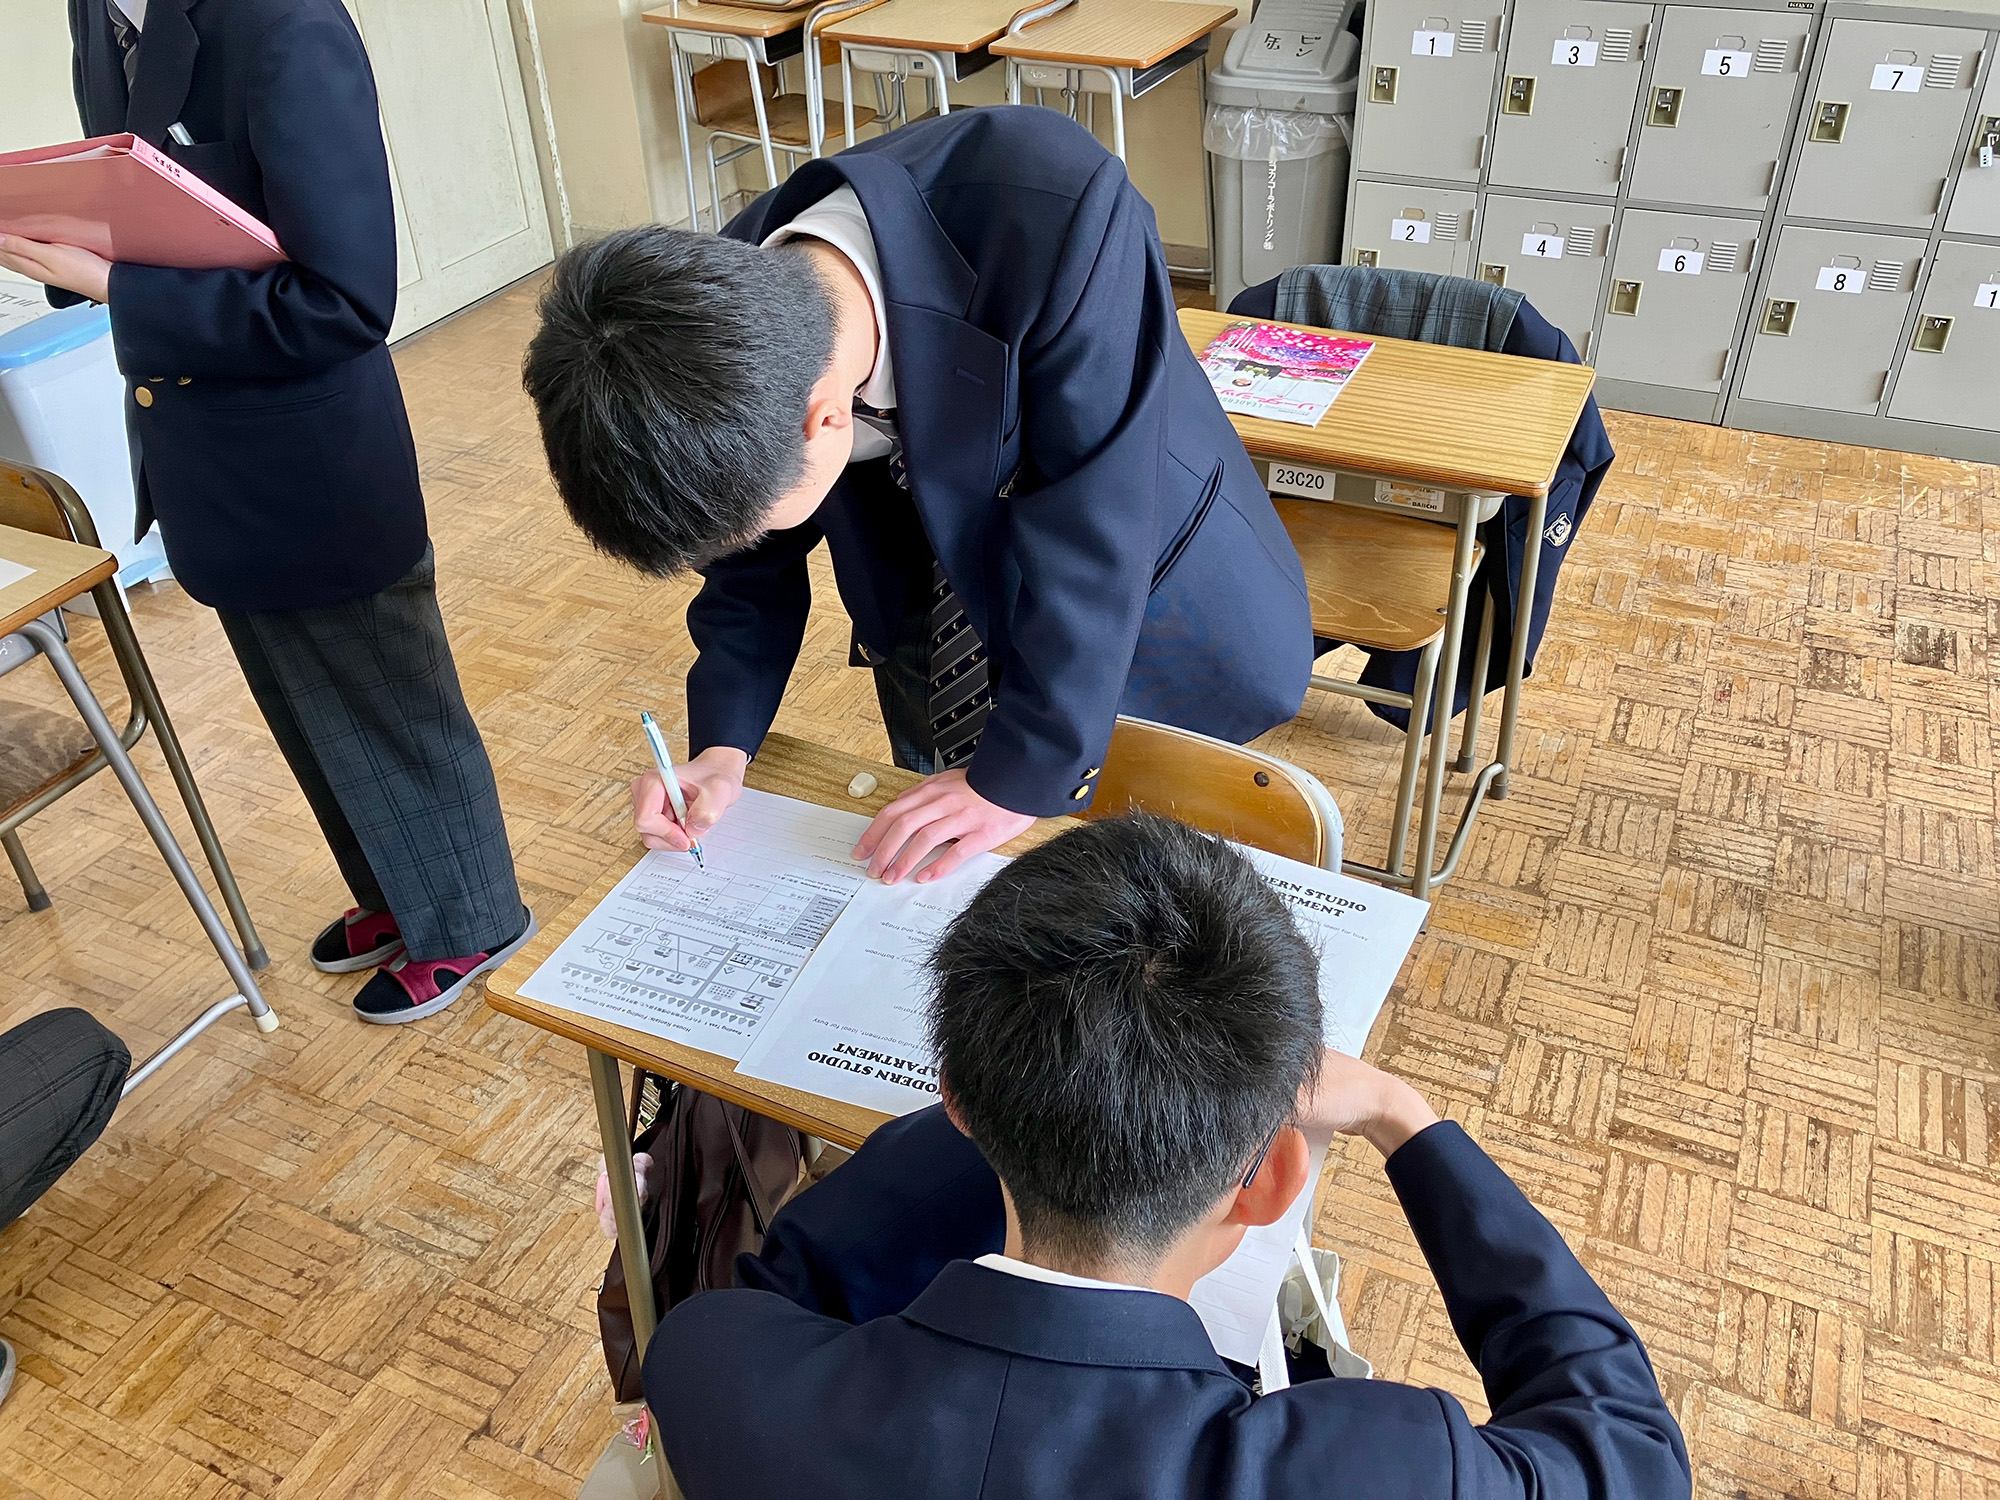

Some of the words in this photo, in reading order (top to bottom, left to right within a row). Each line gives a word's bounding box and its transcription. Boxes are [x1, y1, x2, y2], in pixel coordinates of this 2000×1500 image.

[1296, 35, 1322, 58] ビン
[1429, 37, 1436, 55] 1
[1568, 46, 1580, 65] 3
[1719, 56, 1732, 76] 5
[1891, 70, 1904, 90] 7
[1405, 225, 1416, 242] 2
[1536, 239, 1547, 257] 4
[1674, 255, 1687, 272] 6
[1833, 273, 1847, 291] 8
[1276, 468, 1325, 490] 23C20
[1412, 501, 1438, 510] DAIICHI
[1260, 873, 1302, 893] DERN
[1304, 888, 1367, 912] STUDIO
[813, 1017, 829, 1026] busy
[841, 1025, 858, 1034] ideal
[898, 1038, 919, 1049] studio
[807, 1051, 874, 1076] STUDIO
[832, 1042, 940, 1078] APARTMENT
[875, 1068, 937, 1094] ODERN
